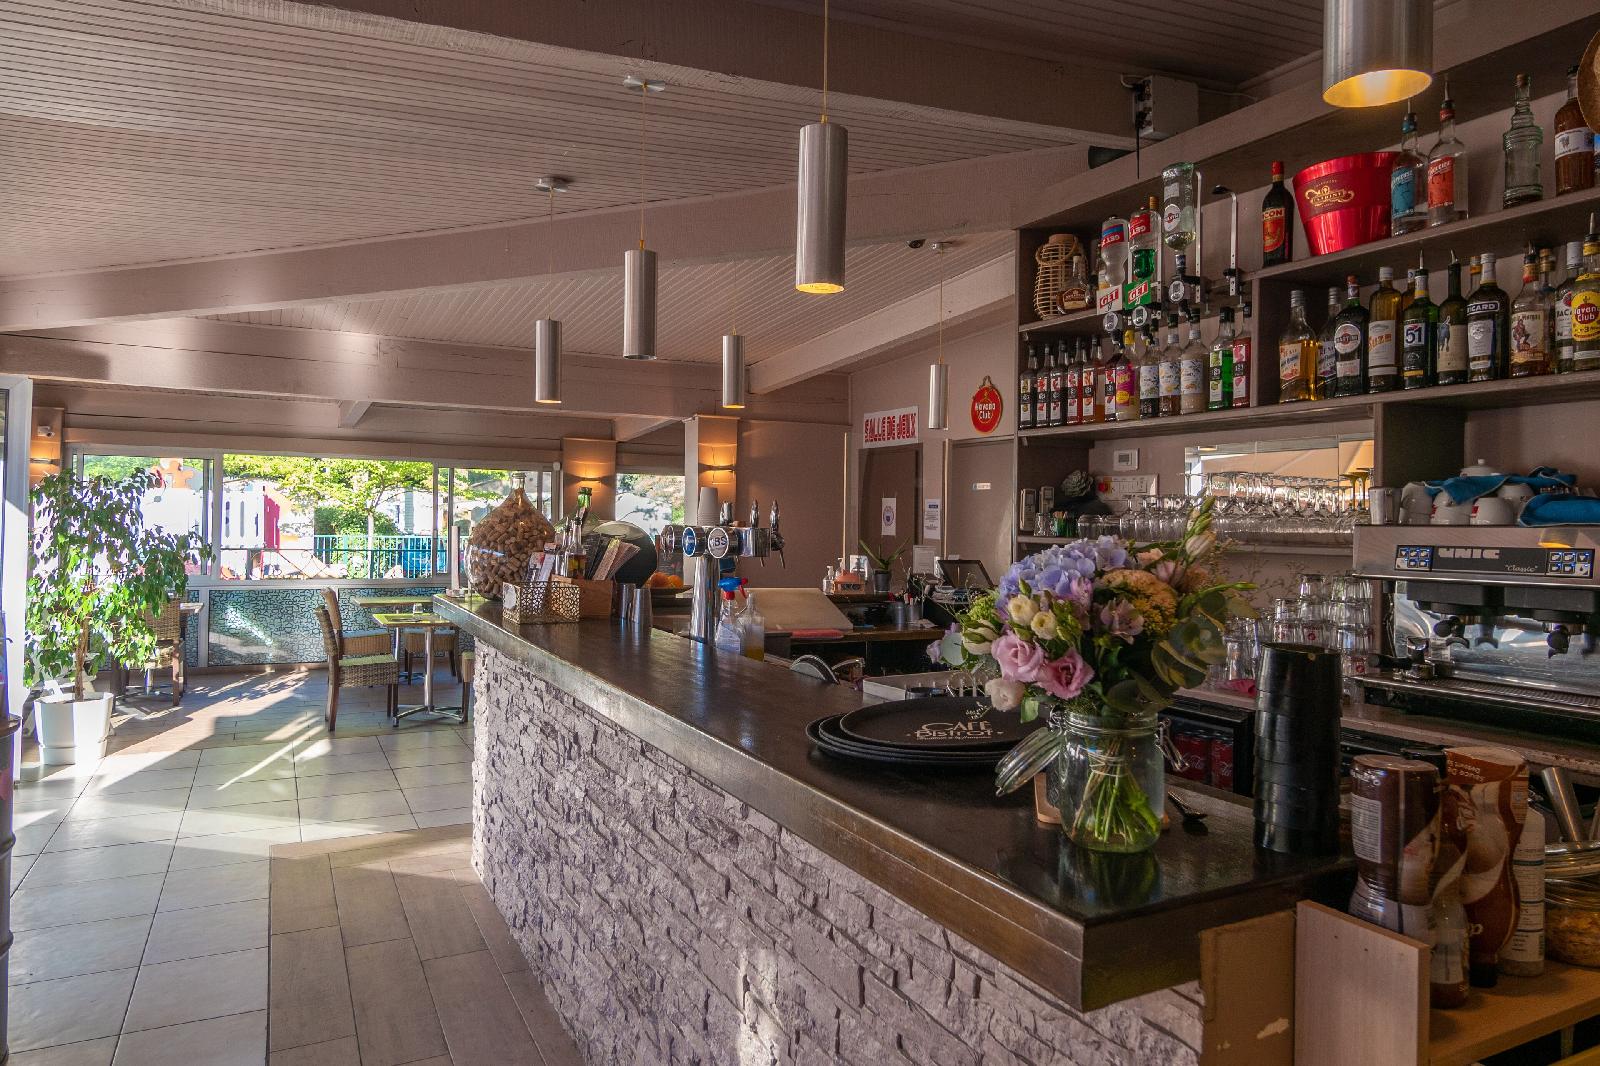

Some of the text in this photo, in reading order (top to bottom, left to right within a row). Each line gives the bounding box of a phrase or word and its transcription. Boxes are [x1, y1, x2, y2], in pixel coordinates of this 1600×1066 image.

[1577, 314, 1596, 323] Club
[1405, 327, 1422, 345] 51
[1438, 548, 1500, 559] UNIC
